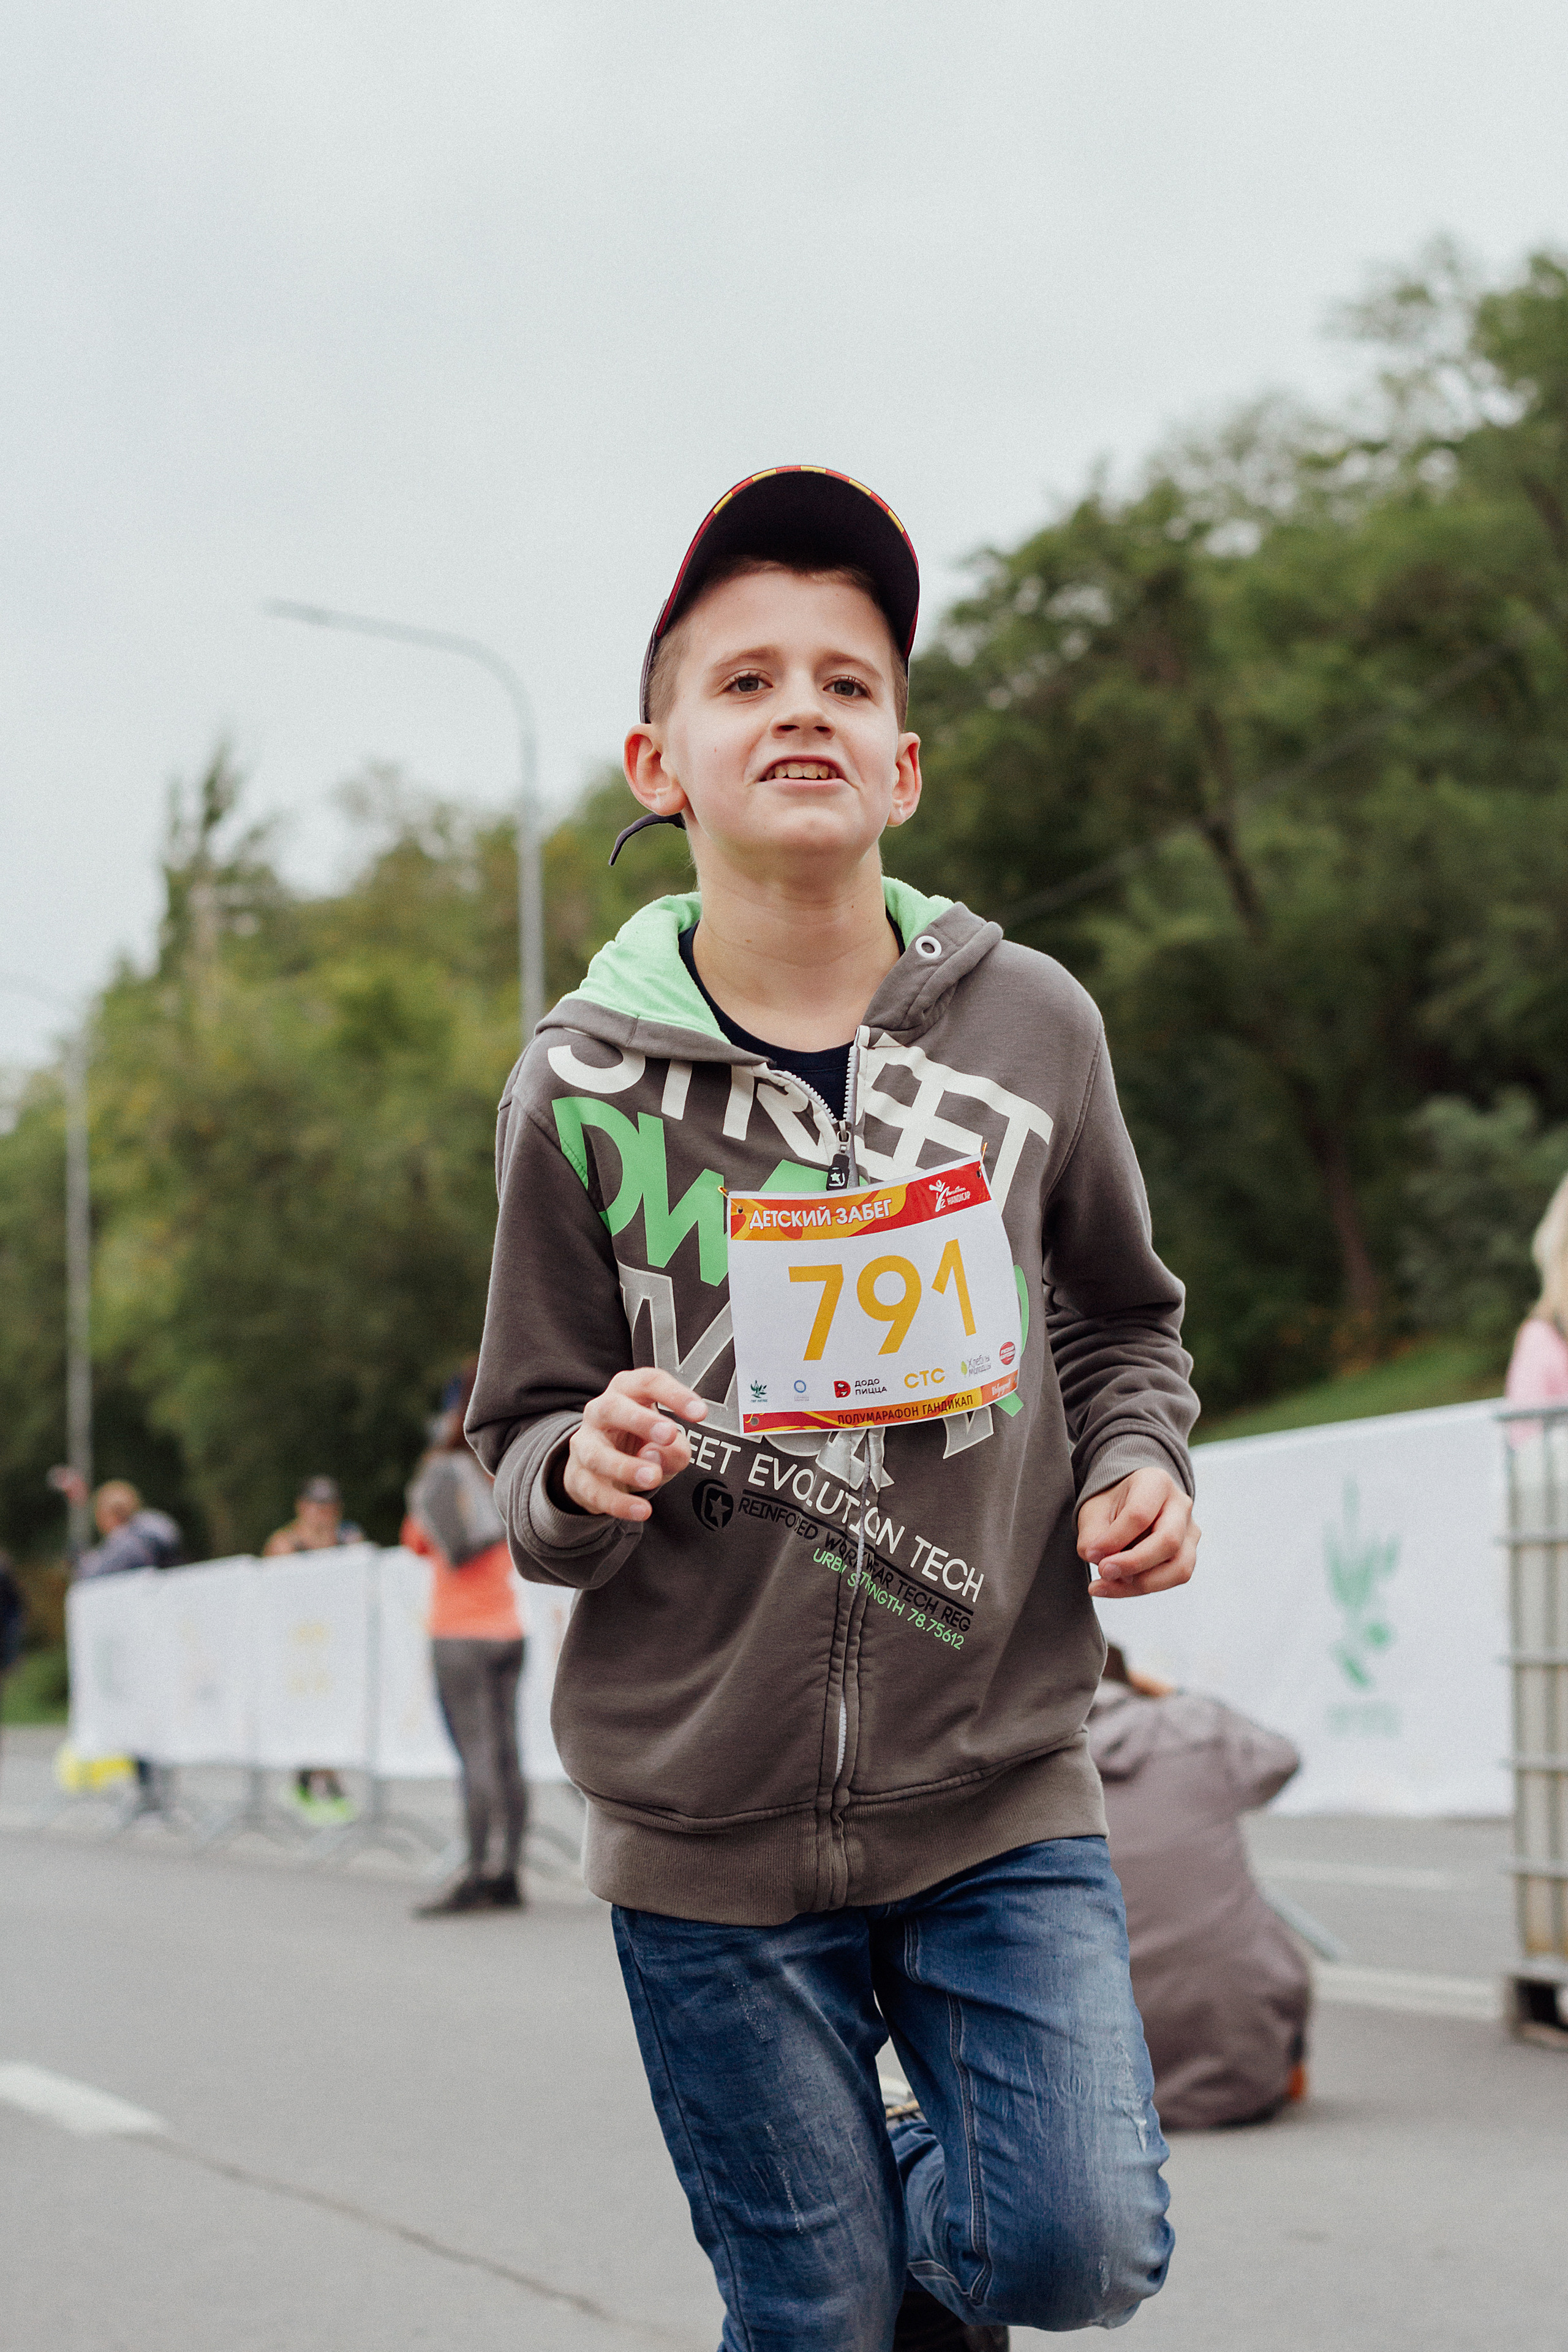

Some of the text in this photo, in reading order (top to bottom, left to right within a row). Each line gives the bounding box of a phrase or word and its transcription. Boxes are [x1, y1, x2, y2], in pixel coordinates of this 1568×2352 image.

[749, 1199, 892, 1230] ДЕТСКИЙ ЗАБЕГ
[788, 1238, 976, 1362] 791
[854, 1378, 880, 1388] ДОДО
[855, 1386, 888, 1395] ПИЦЦА
[904, 1368, 946, 1389] СТС
[837, 1395, 973, 1425] ПОЛУМАРАФОН ГАНДИКАП
[675, 1423, 741, 1474] EET
[910, 1535, 984, 1602] TECH
[895, 1579, 938, 1615] TECH
[941, 1607, 971, 1632] REG
[907, 1608, 965, 1650] 78.75612
